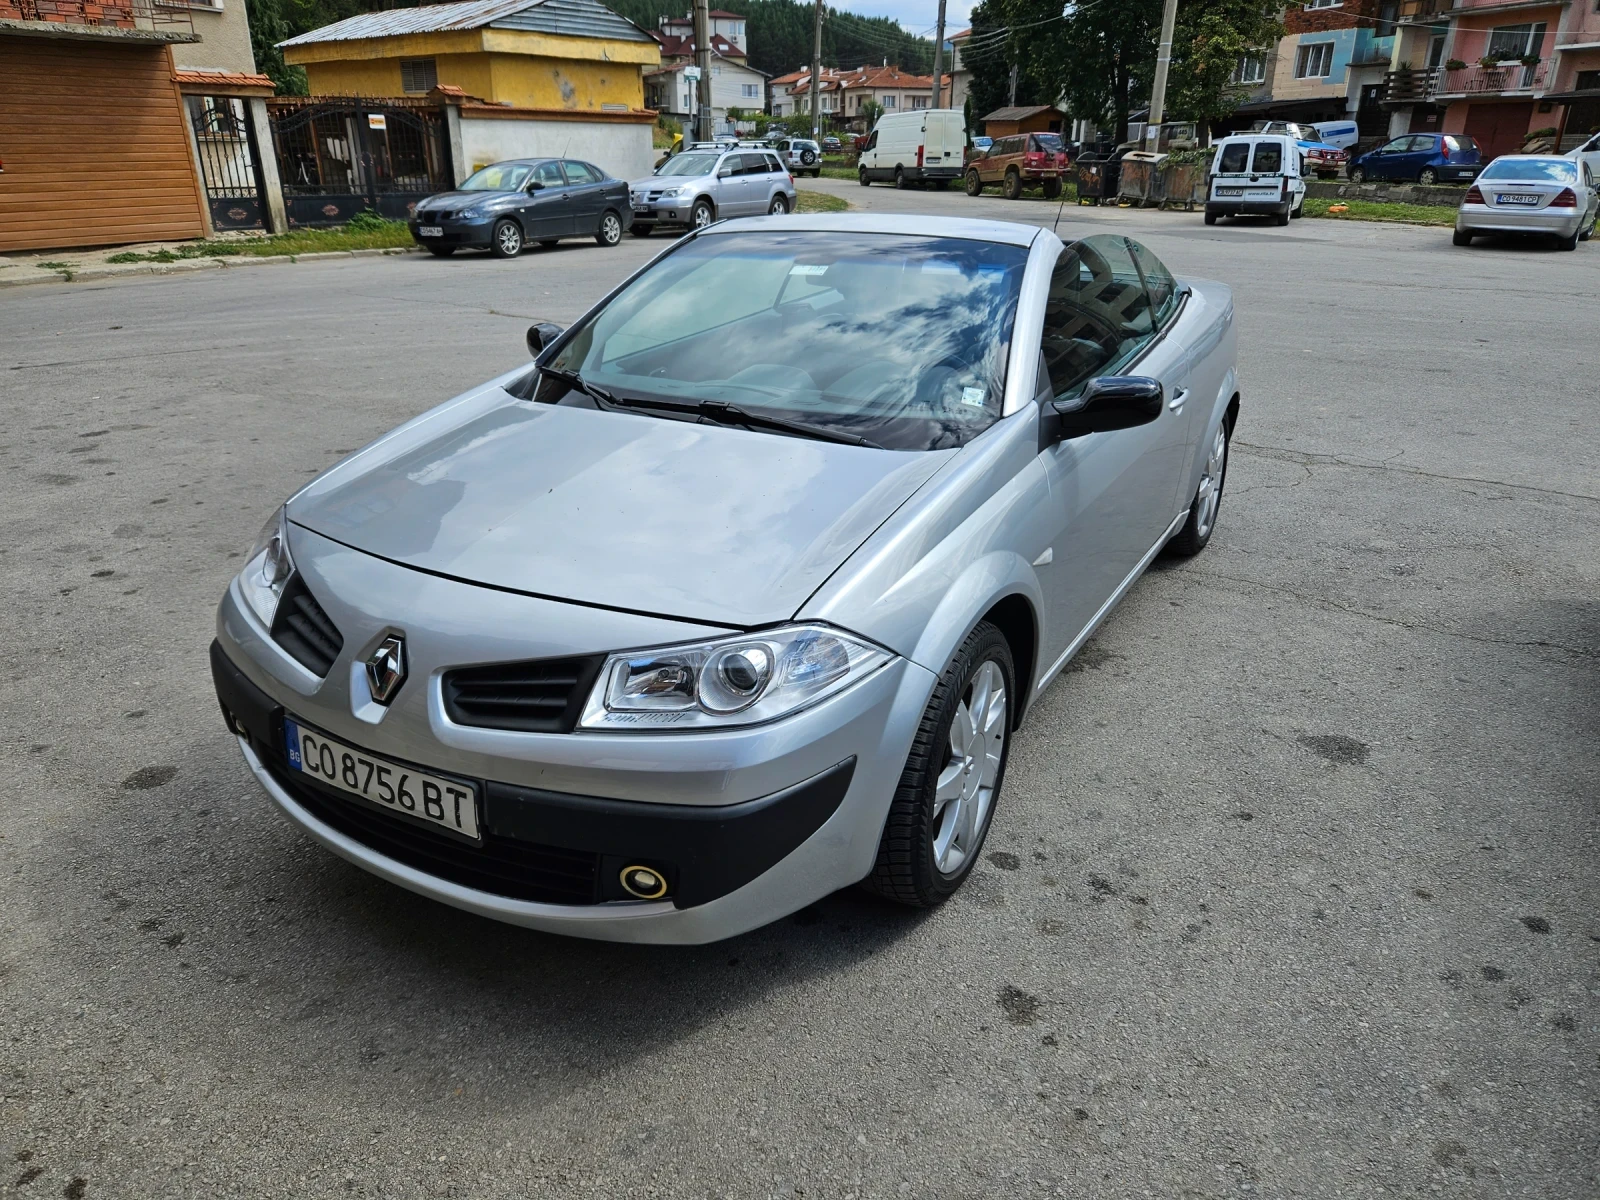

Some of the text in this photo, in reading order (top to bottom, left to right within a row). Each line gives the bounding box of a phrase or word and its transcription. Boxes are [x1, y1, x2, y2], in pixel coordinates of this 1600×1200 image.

[289, 749, 300, 763] BG
[302, 734, 467, 828] CO 8756 BT
